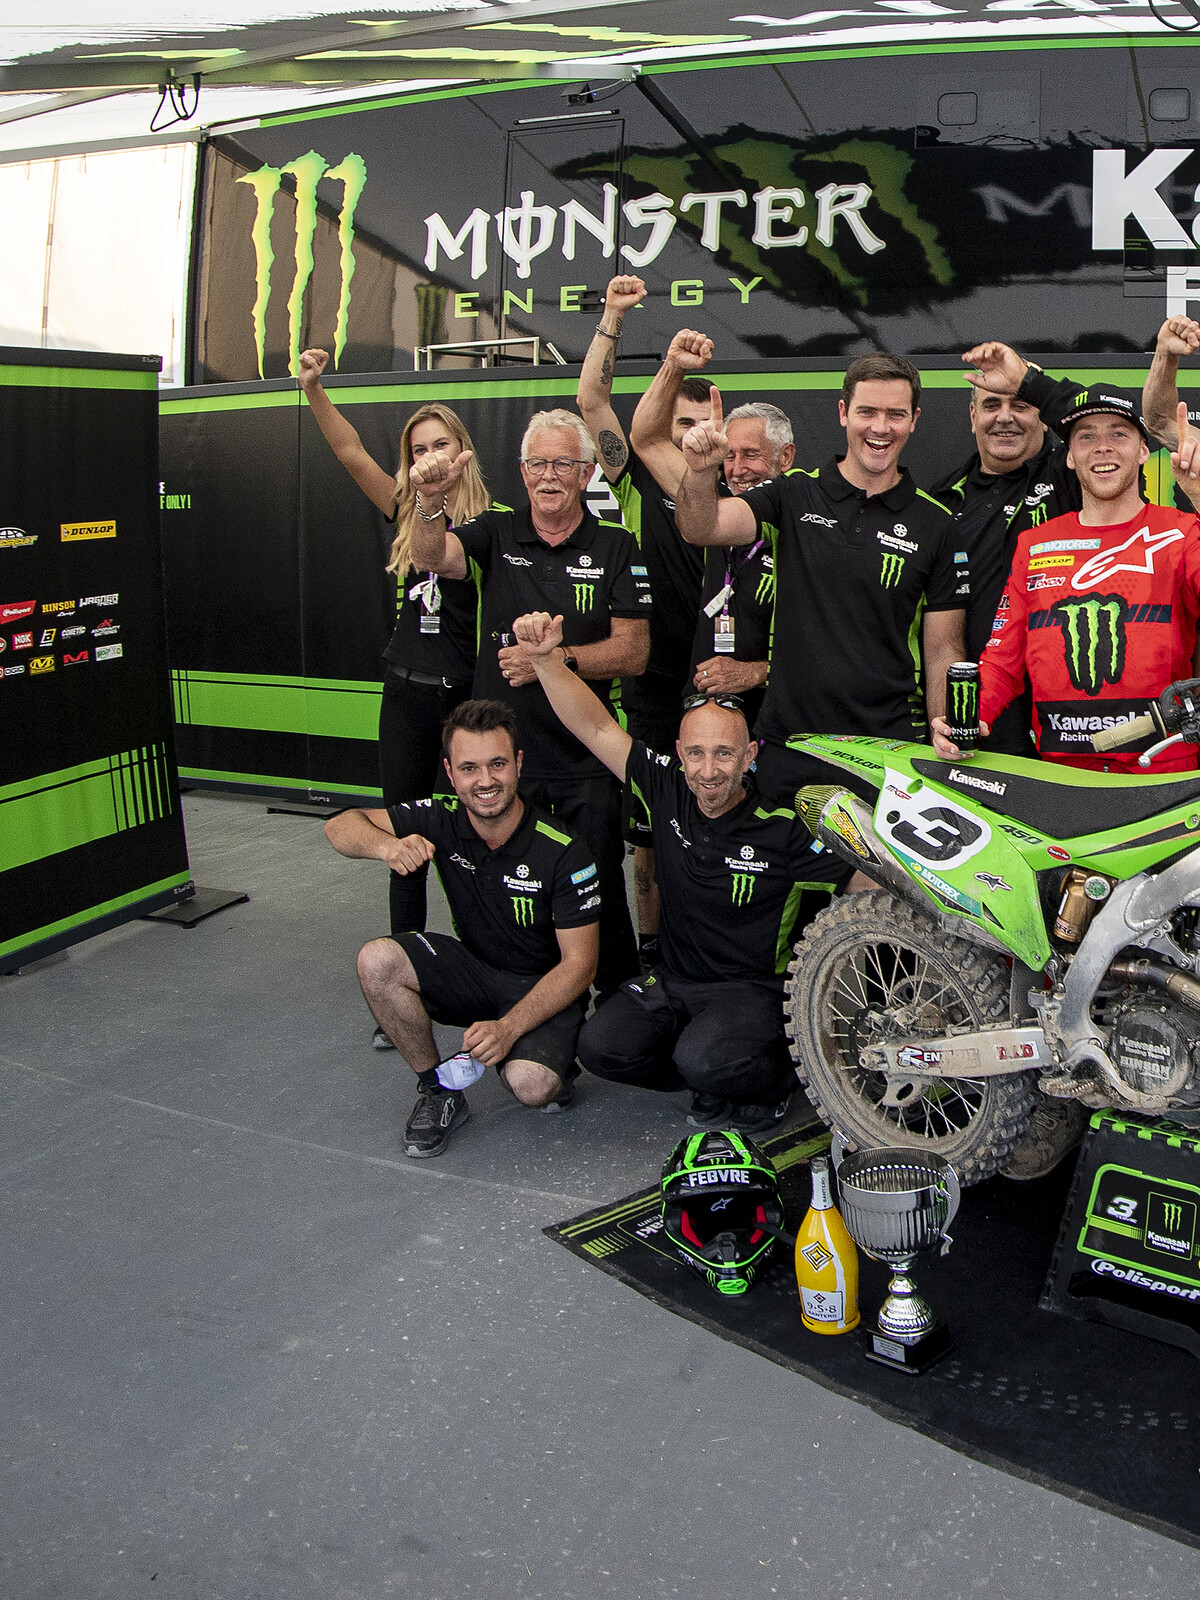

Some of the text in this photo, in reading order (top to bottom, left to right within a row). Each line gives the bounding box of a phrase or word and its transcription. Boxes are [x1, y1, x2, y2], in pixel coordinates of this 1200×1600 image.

[454, 276, 763, 319] ENEGY
[70, 525, 114, 536] DUNLOP
[1043, 539, 1097, 552] MOTOREX
[41, 600, 76, 613] HINSON
[14, 634, 32, 645] NGK
[831, 750, 885, 769] DUNLOP
[948, 768, 1007, 796] Kawasaki
[890, 806, 983, 861] 3
[997, 824, 1045, 845] 450
[725, 856, 769, 869] Kawasaki
[503, 875, 543, 889] Kawasaki
[920, 868, 961, 900] MOTOREX
[688, 1169, 750, 1188] FEBVRE
[1106, 1196, 1139, 1218] 3
[1147, 1231, 1191, 1251] Kawasaki
[1092, 1260, 1200, 1300] Polisport
